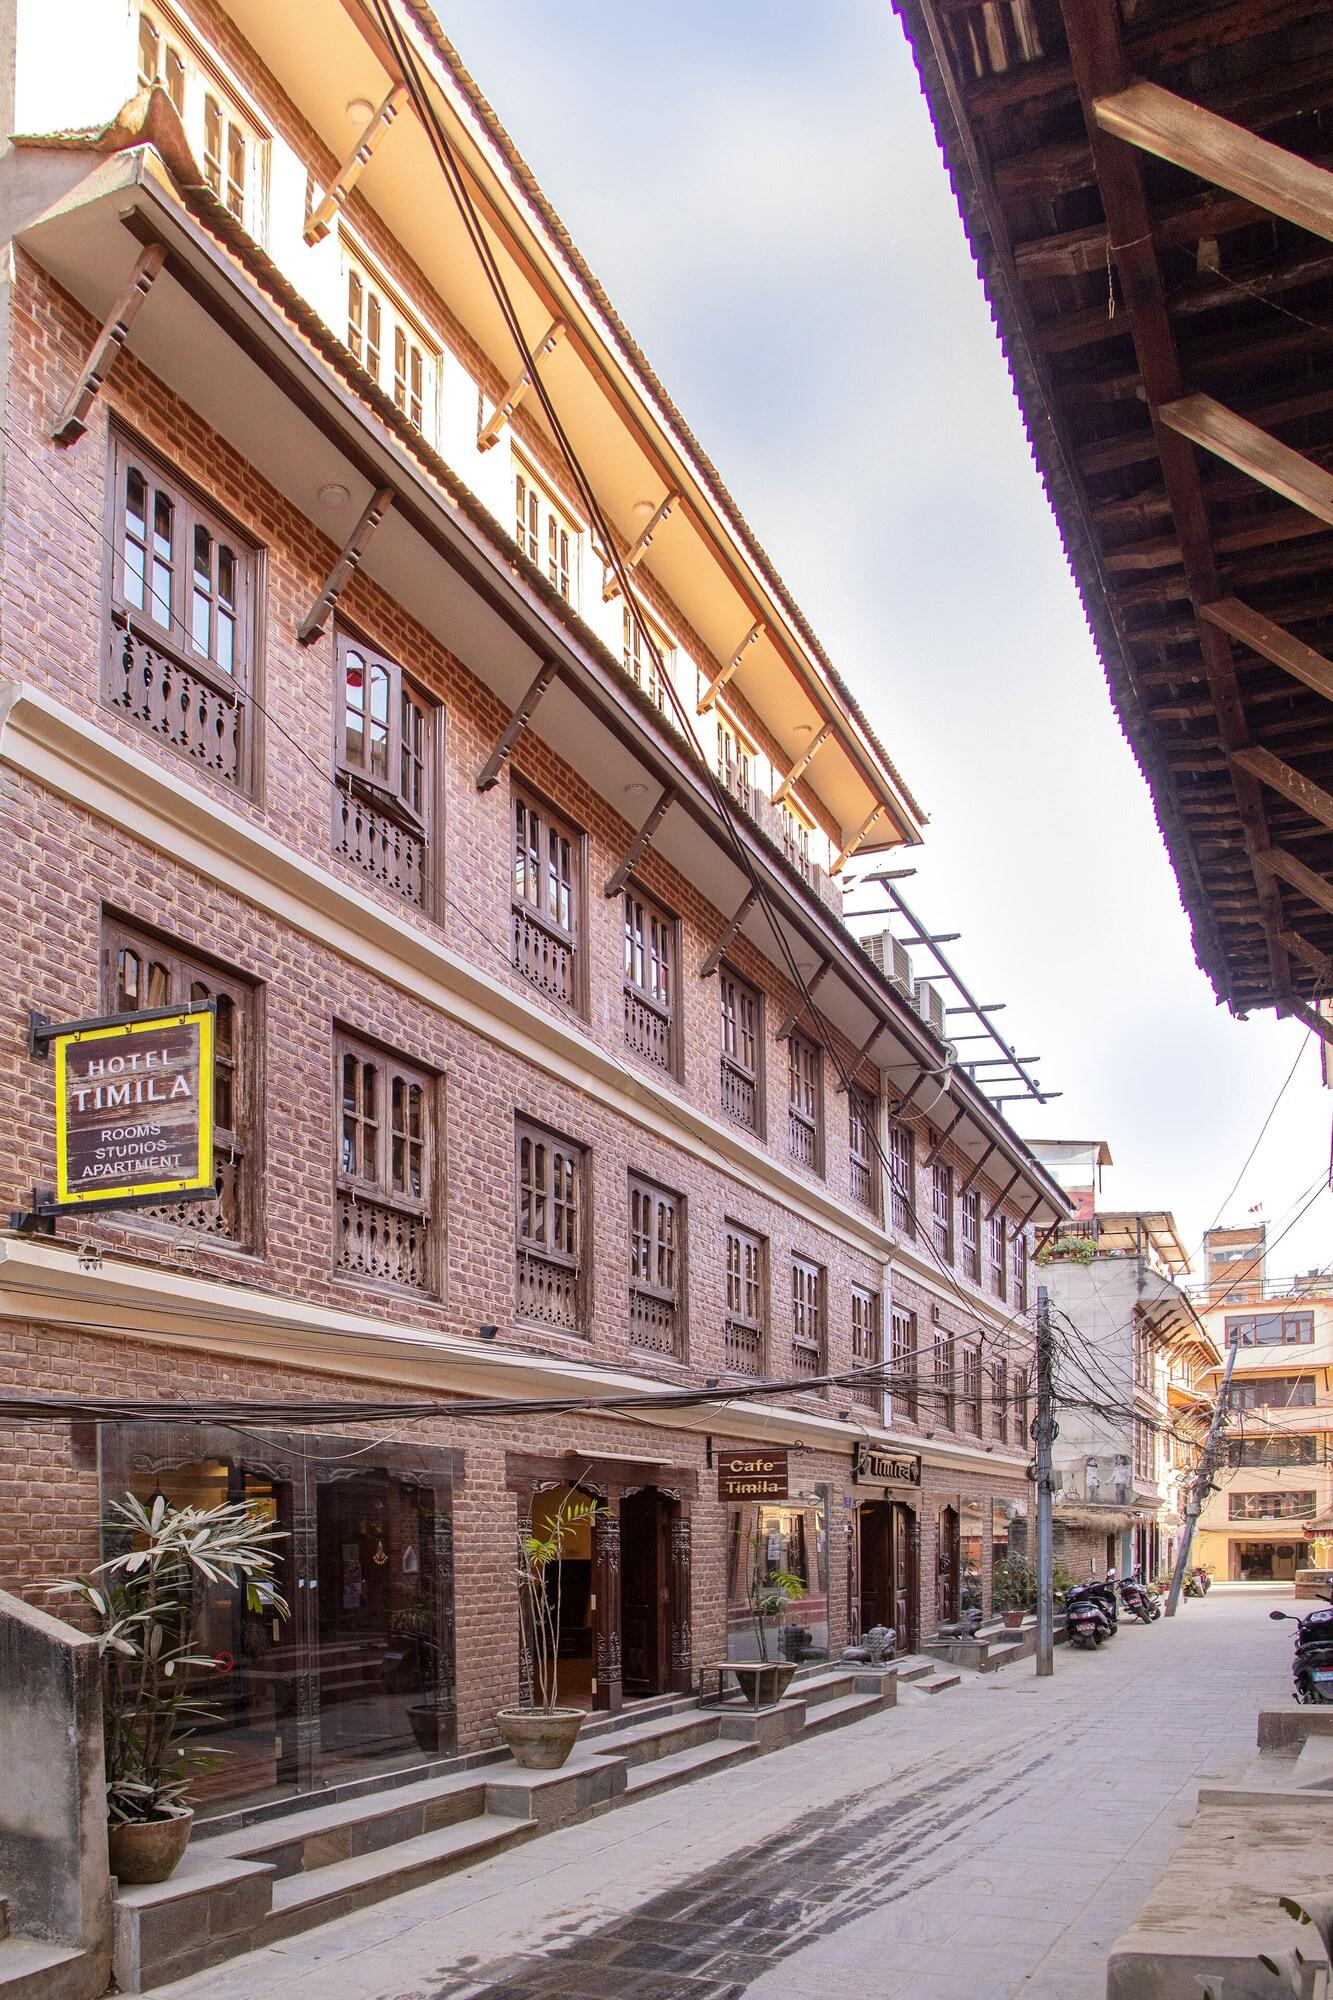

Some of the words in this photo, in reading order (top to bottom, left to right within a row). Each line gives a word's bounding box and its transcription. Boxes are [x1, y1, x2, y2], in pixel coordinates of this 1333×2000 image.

[88, 1049, 175, 1077] HOTEL
[72, 1074, 192, 1112] TIMILA
[101, 1124, 161, 1142] ROOMS
[95, 1139, 169, 1160] STUDIOS
[81, 1153, 182, 1178] APARTMENT
[730, 1459, 774, 1473] Cafe
[725, 1480, 778, 1494] Timila
